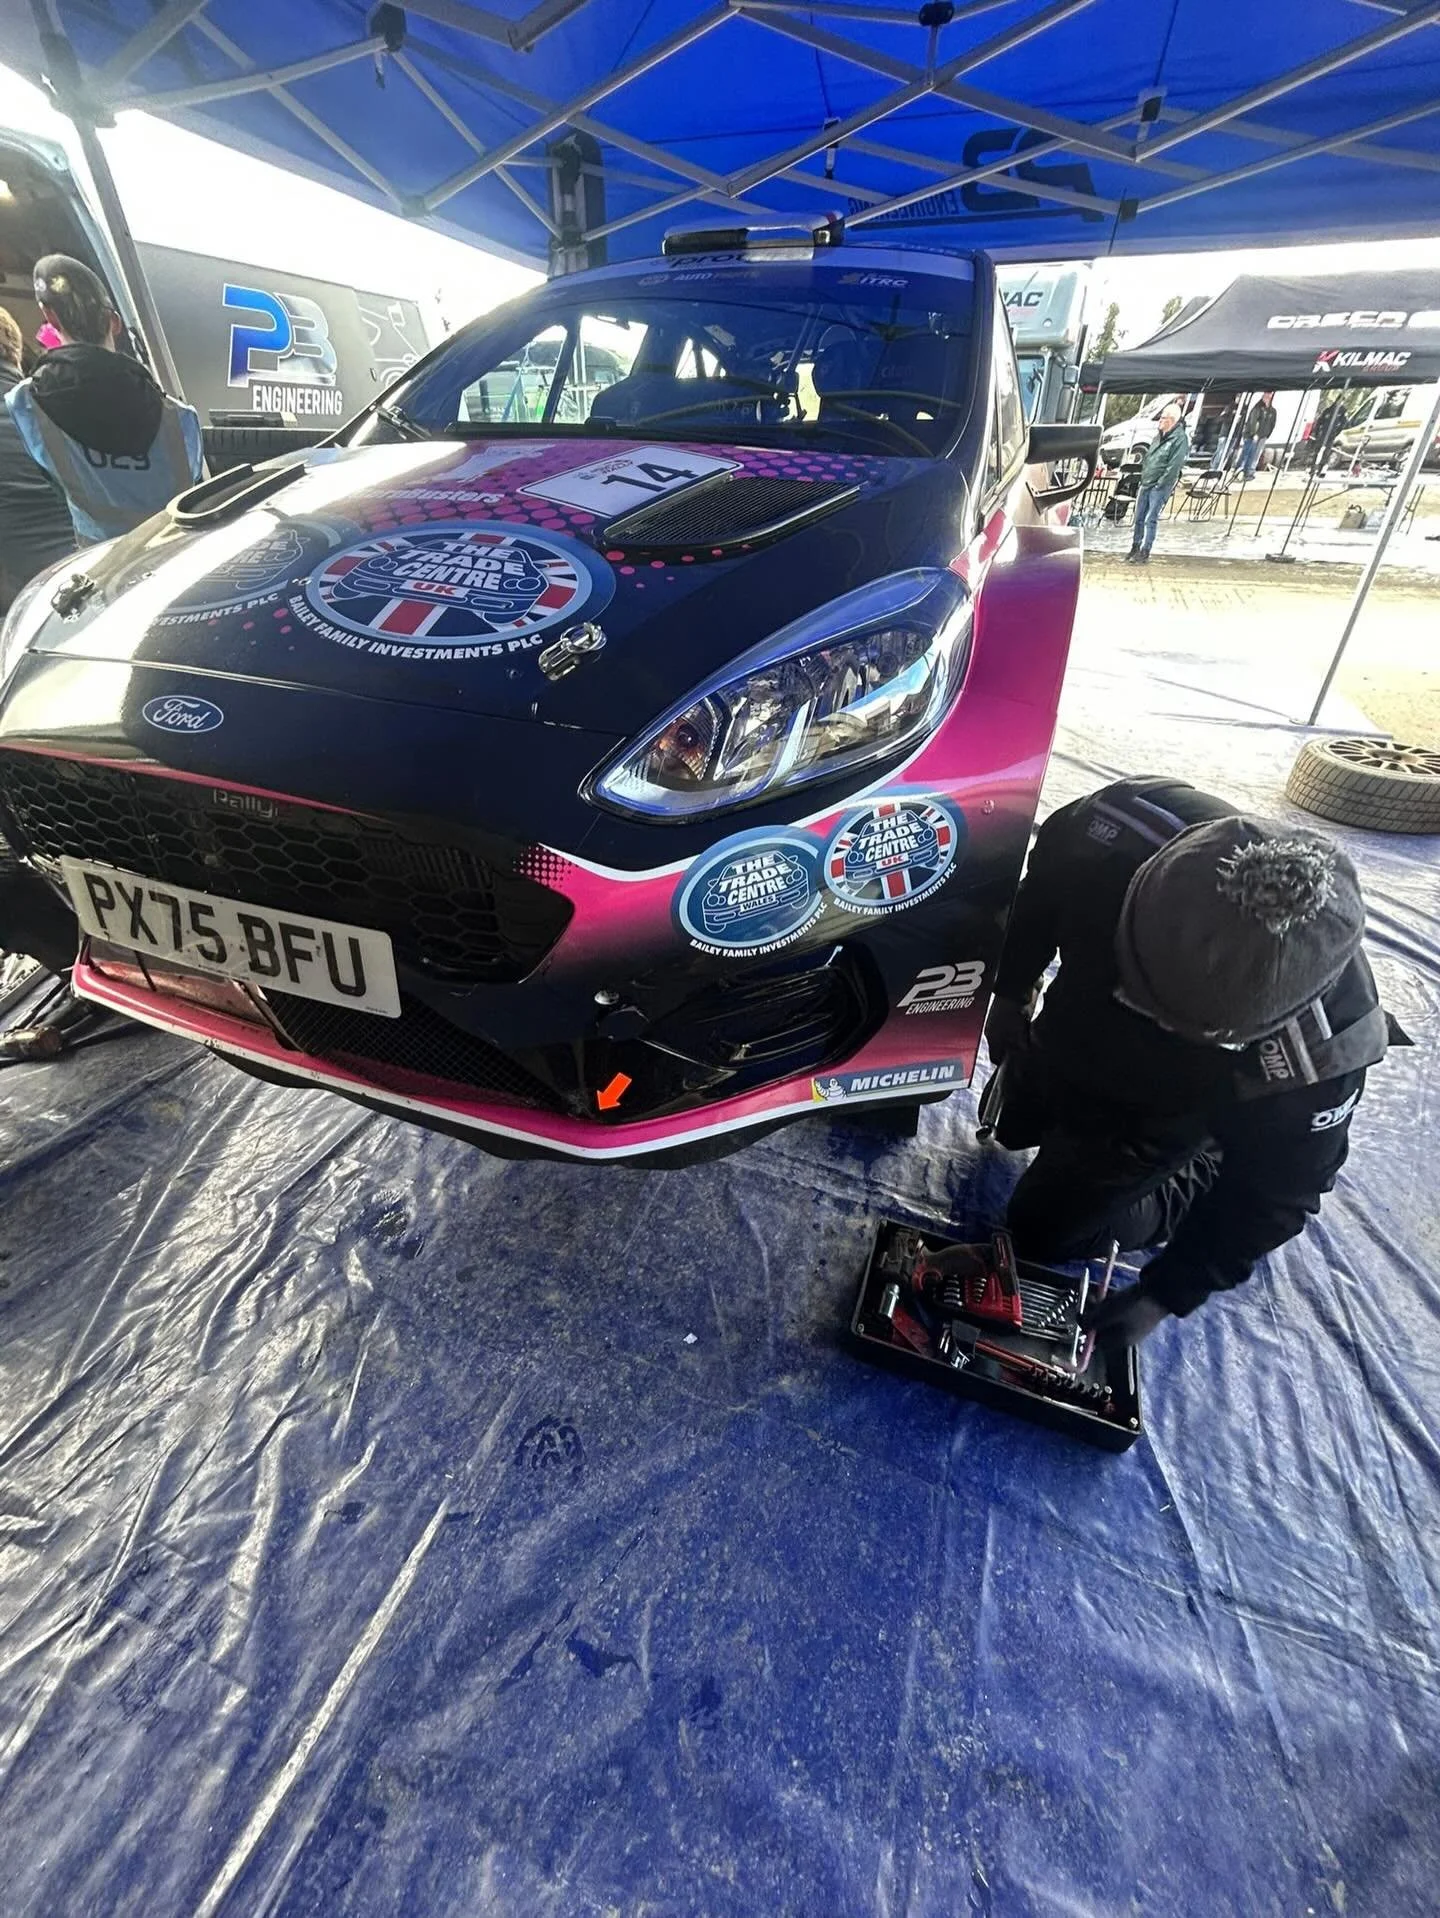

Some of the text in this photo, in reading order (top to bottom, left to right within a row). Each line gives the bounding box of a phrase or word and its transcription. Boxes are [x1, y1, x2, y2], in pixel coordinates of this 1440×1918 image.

[1332, 351, 1412, 367] KILMAC
[252, 385, 343, 416] ENGINEERING
[600, 462, 699, 492] 14
[404, 549, 526, 577] TRADE
[441, 541, 516, 559] THE
[393, 563, 502, 591] CENTRE
[412, 582, 458, 596] UK
[246, 592, 279, 609] PLC
[288, 594, 544, 660] BAILEY FAMILY INVESTMENTS PLC
[152, 698, 212, 729] Ford
[858, 821, 924, 850] TRADE
[871, 812, 909, 833] THE
[864, 834, 919, 863] CENTRE
[881, 855, 905, 867] UK
[718, 863, 793, 894] TRADE
[731, 853, 777, 876] THE
[727, 876, 788, 906] CENTRE
[742, 895, 776, 911] WALES
[833, 862, 958, 916] BAILEY FAMILY INVESTMENTS PLC
[83, 871, 368, 998] PX75 BFU
[689, 901, 828, 958] BAILEY FAMILY INVESTMENTS PLC
[905, 997, 975, 1015] ENGINEERING
[1260, 1039, 1290, 1080] OMP
[850, 1064, 956, 1092] MICHELIN
